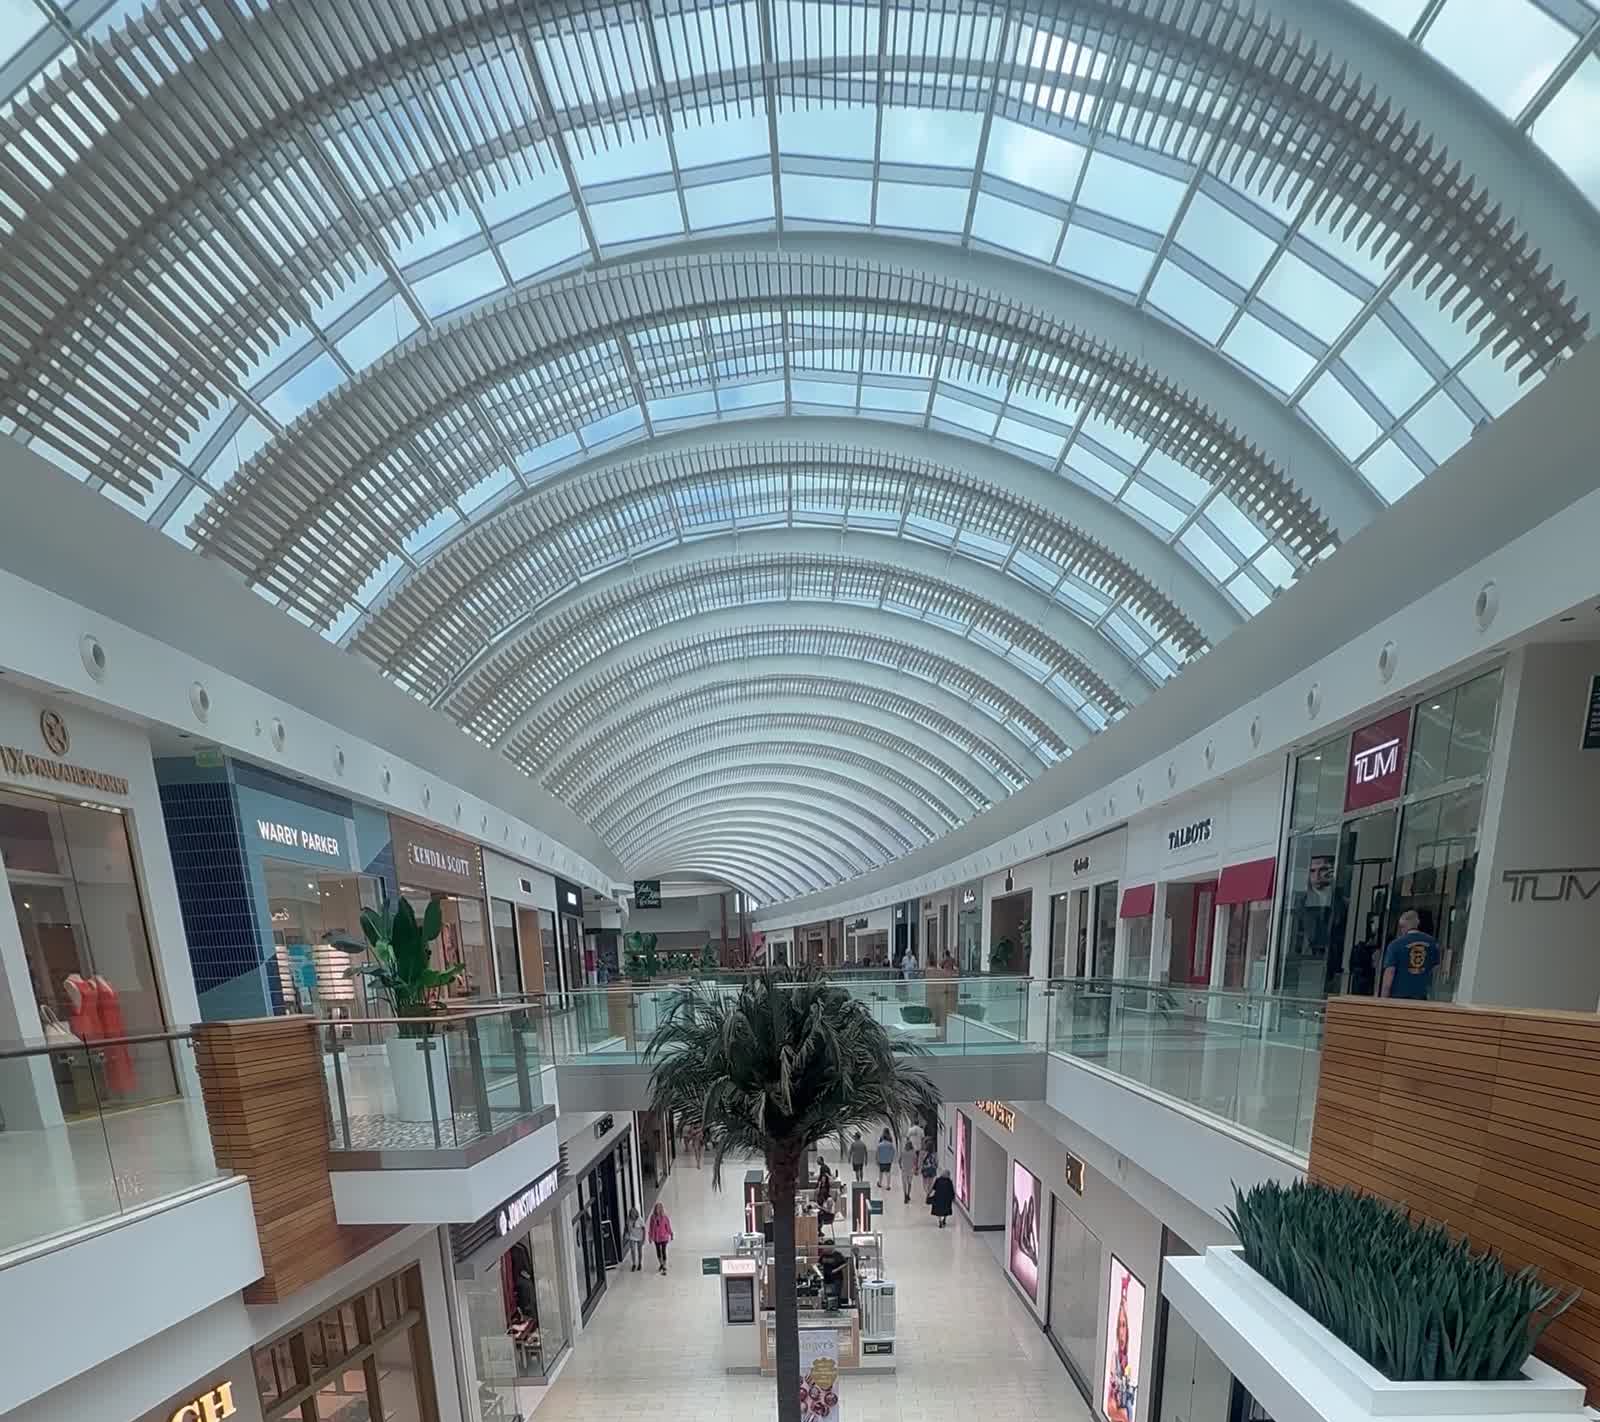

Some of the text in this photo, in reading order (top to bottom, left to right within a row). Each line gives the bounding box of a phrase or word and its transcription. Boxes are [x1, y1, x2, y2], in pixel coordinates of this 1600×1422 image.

[1354, 737, 1400, 784] TUMI
[257, 819, 340, 857] WARBY PARKER
[1168, 818, 1213, 850] TALBOTS
[413, 844, 470, 876] KENDRA SCOTT
[1502, 867, 1600, 903] TUM
